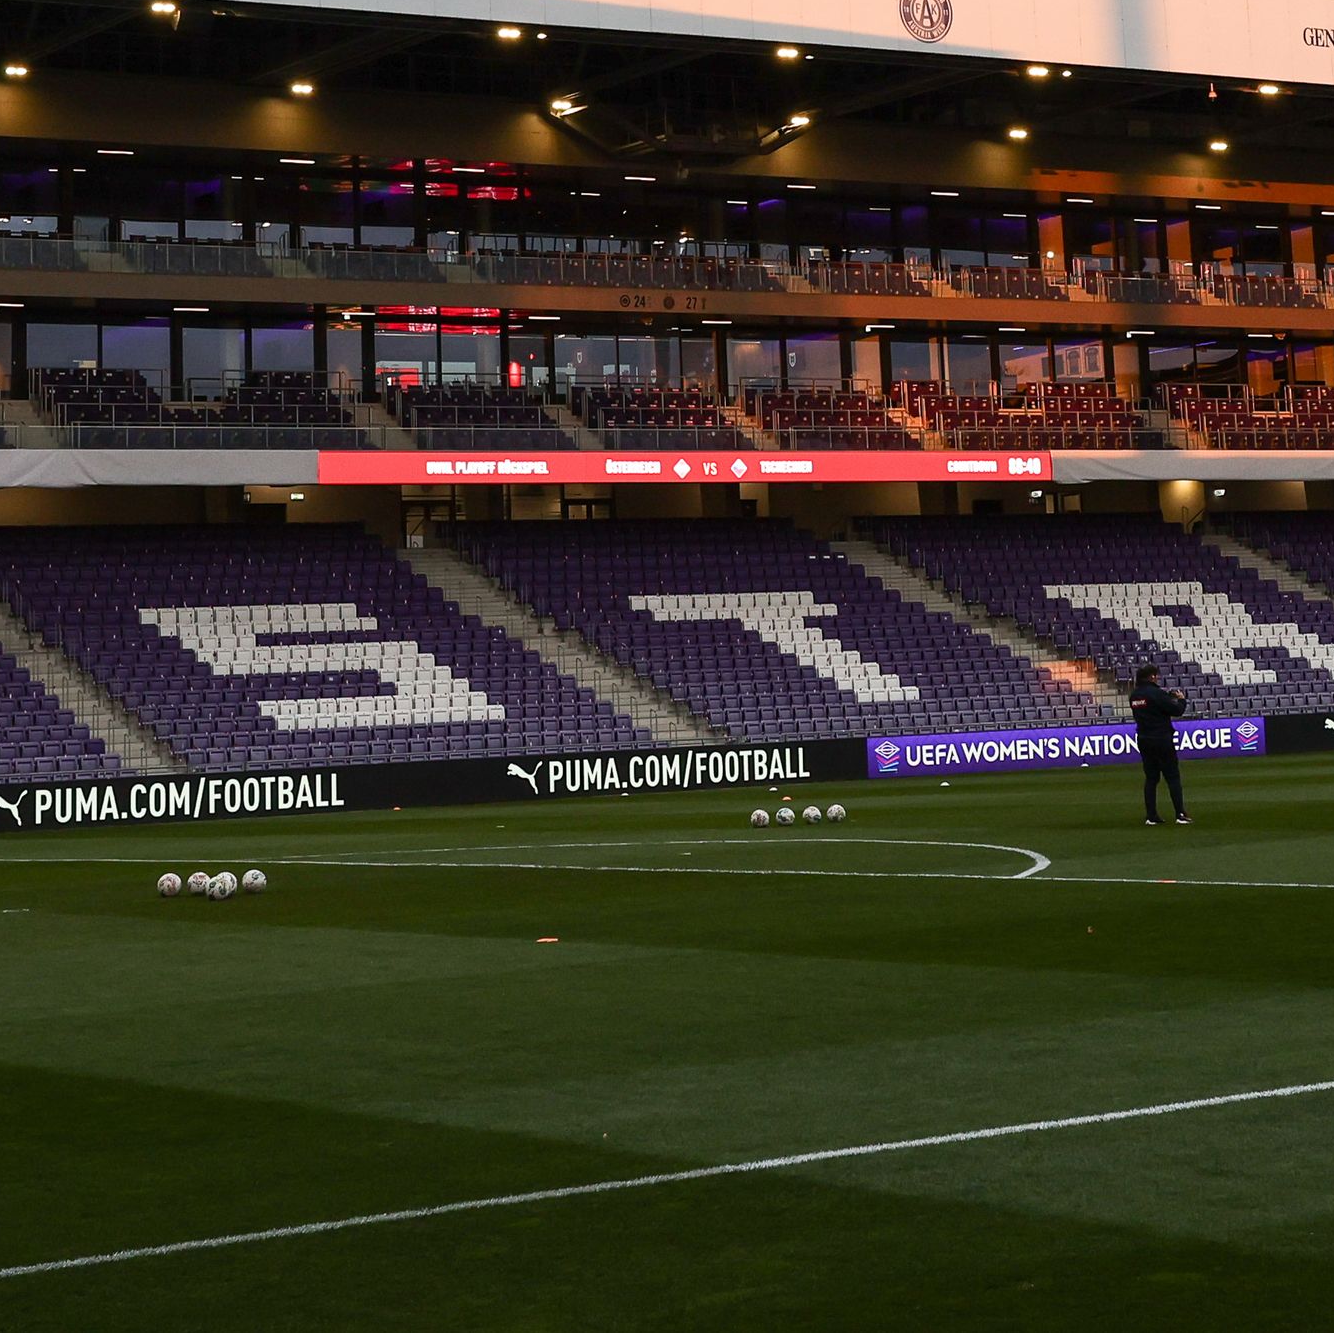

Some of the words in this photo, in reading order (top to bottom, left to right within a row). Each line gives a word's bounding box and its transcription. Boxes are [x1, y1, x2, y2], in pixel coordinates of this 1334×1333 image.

[634, 295, 646, 307] 24
[686, 297, 697, 309] 27
[702, 462, 717, 476] VS
[906, 743, 960, 767] UEFA
[961, 737, 1060, 763] WOMEN'S
[1064, 733, 1140, 757] NATION
[1172, 727, 1232, 751] EAGUE
[548, 747, 811, 793] PUMA.COM/FOOTBALL
[35, 772, 345, 825] PUMA.COM/FOOTBALL
